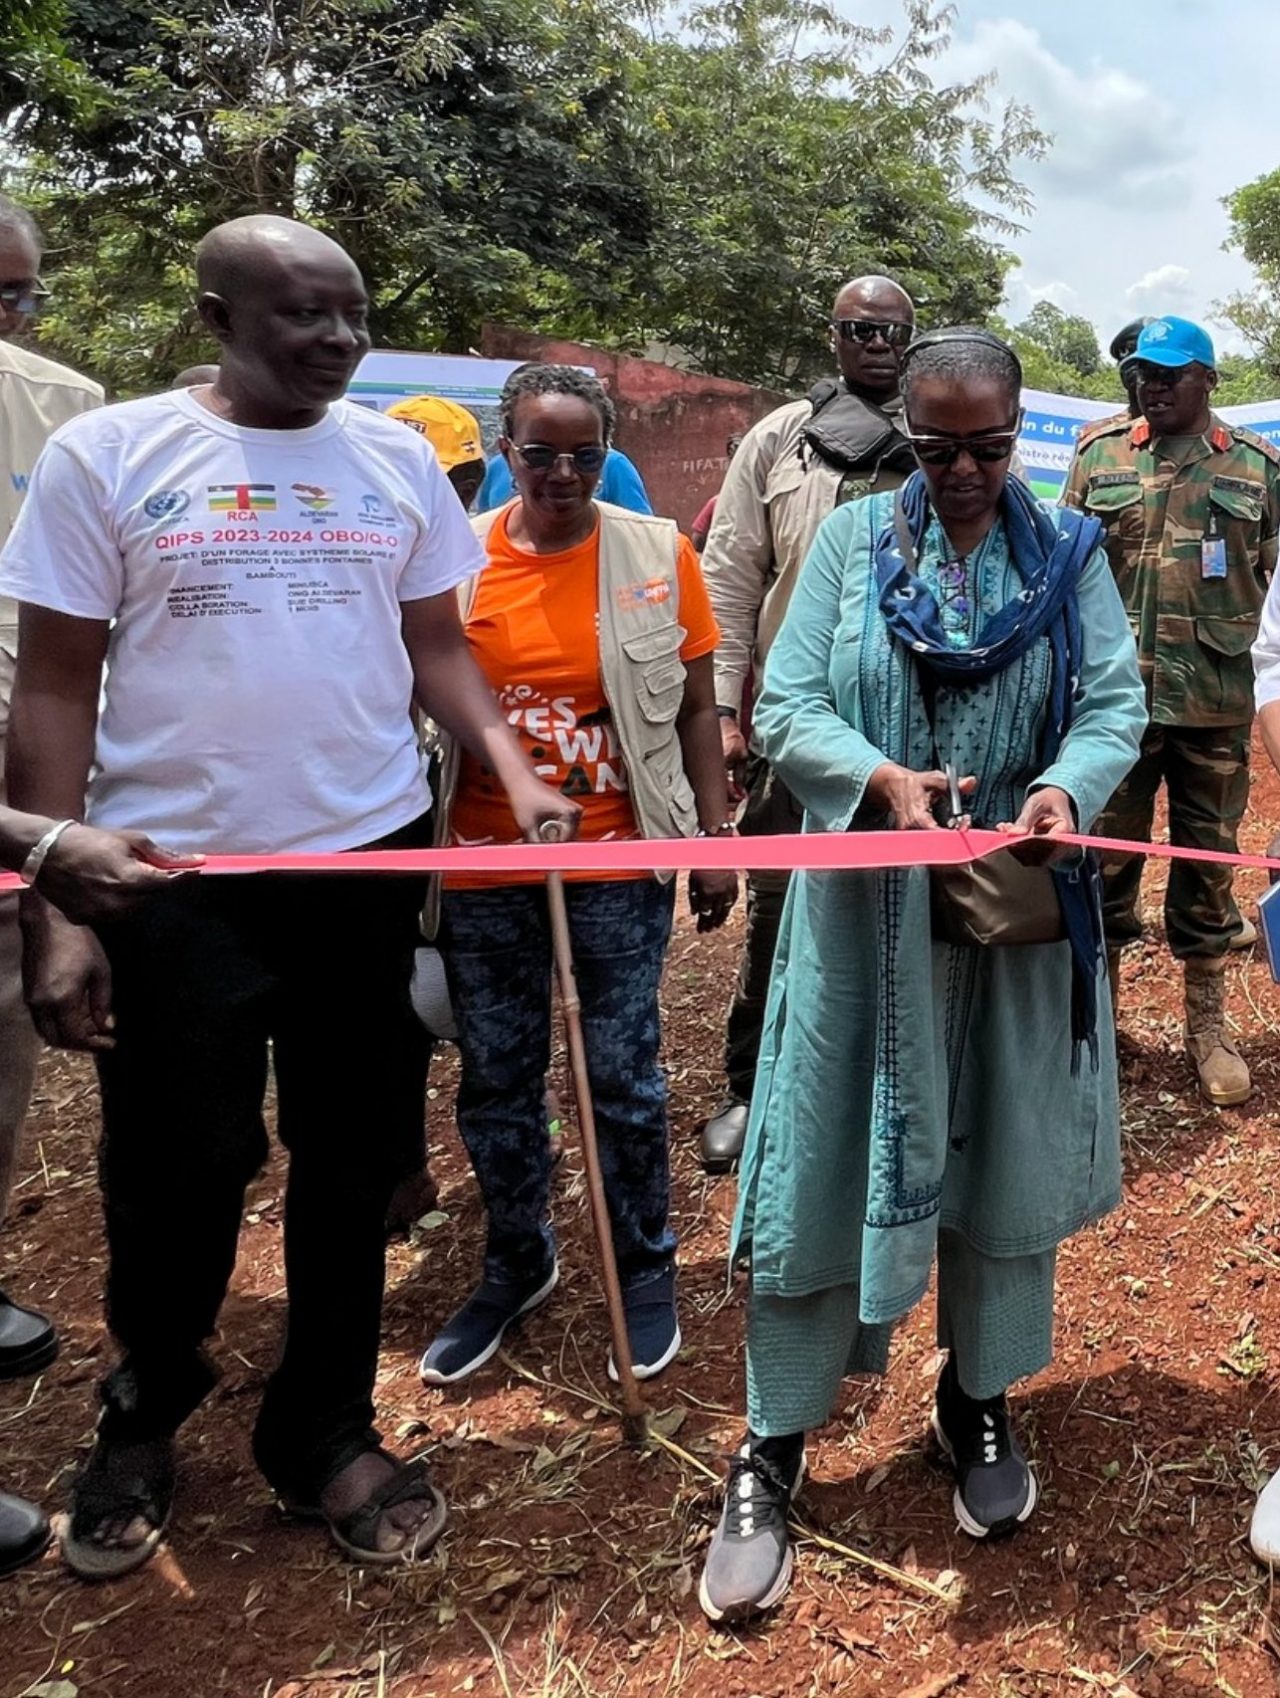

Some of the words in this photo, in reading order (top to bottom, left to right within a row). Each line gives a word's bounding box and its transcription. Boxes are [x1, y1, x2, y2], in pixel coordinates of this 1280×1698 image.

[1041, 420, 1065, 436] du
[227, 511, 259, 522] RCA
[155, 531, 205, 549] QIPS
[212, 529, 313, 543] 2023-2024
[229, 549, 269, 557] FORAGE
[272, 549, 297, 557] AVEC
[202, 558, 271, 566] DISTRIBUTION
[246, 572, 297, 580] BAMBOUTI
